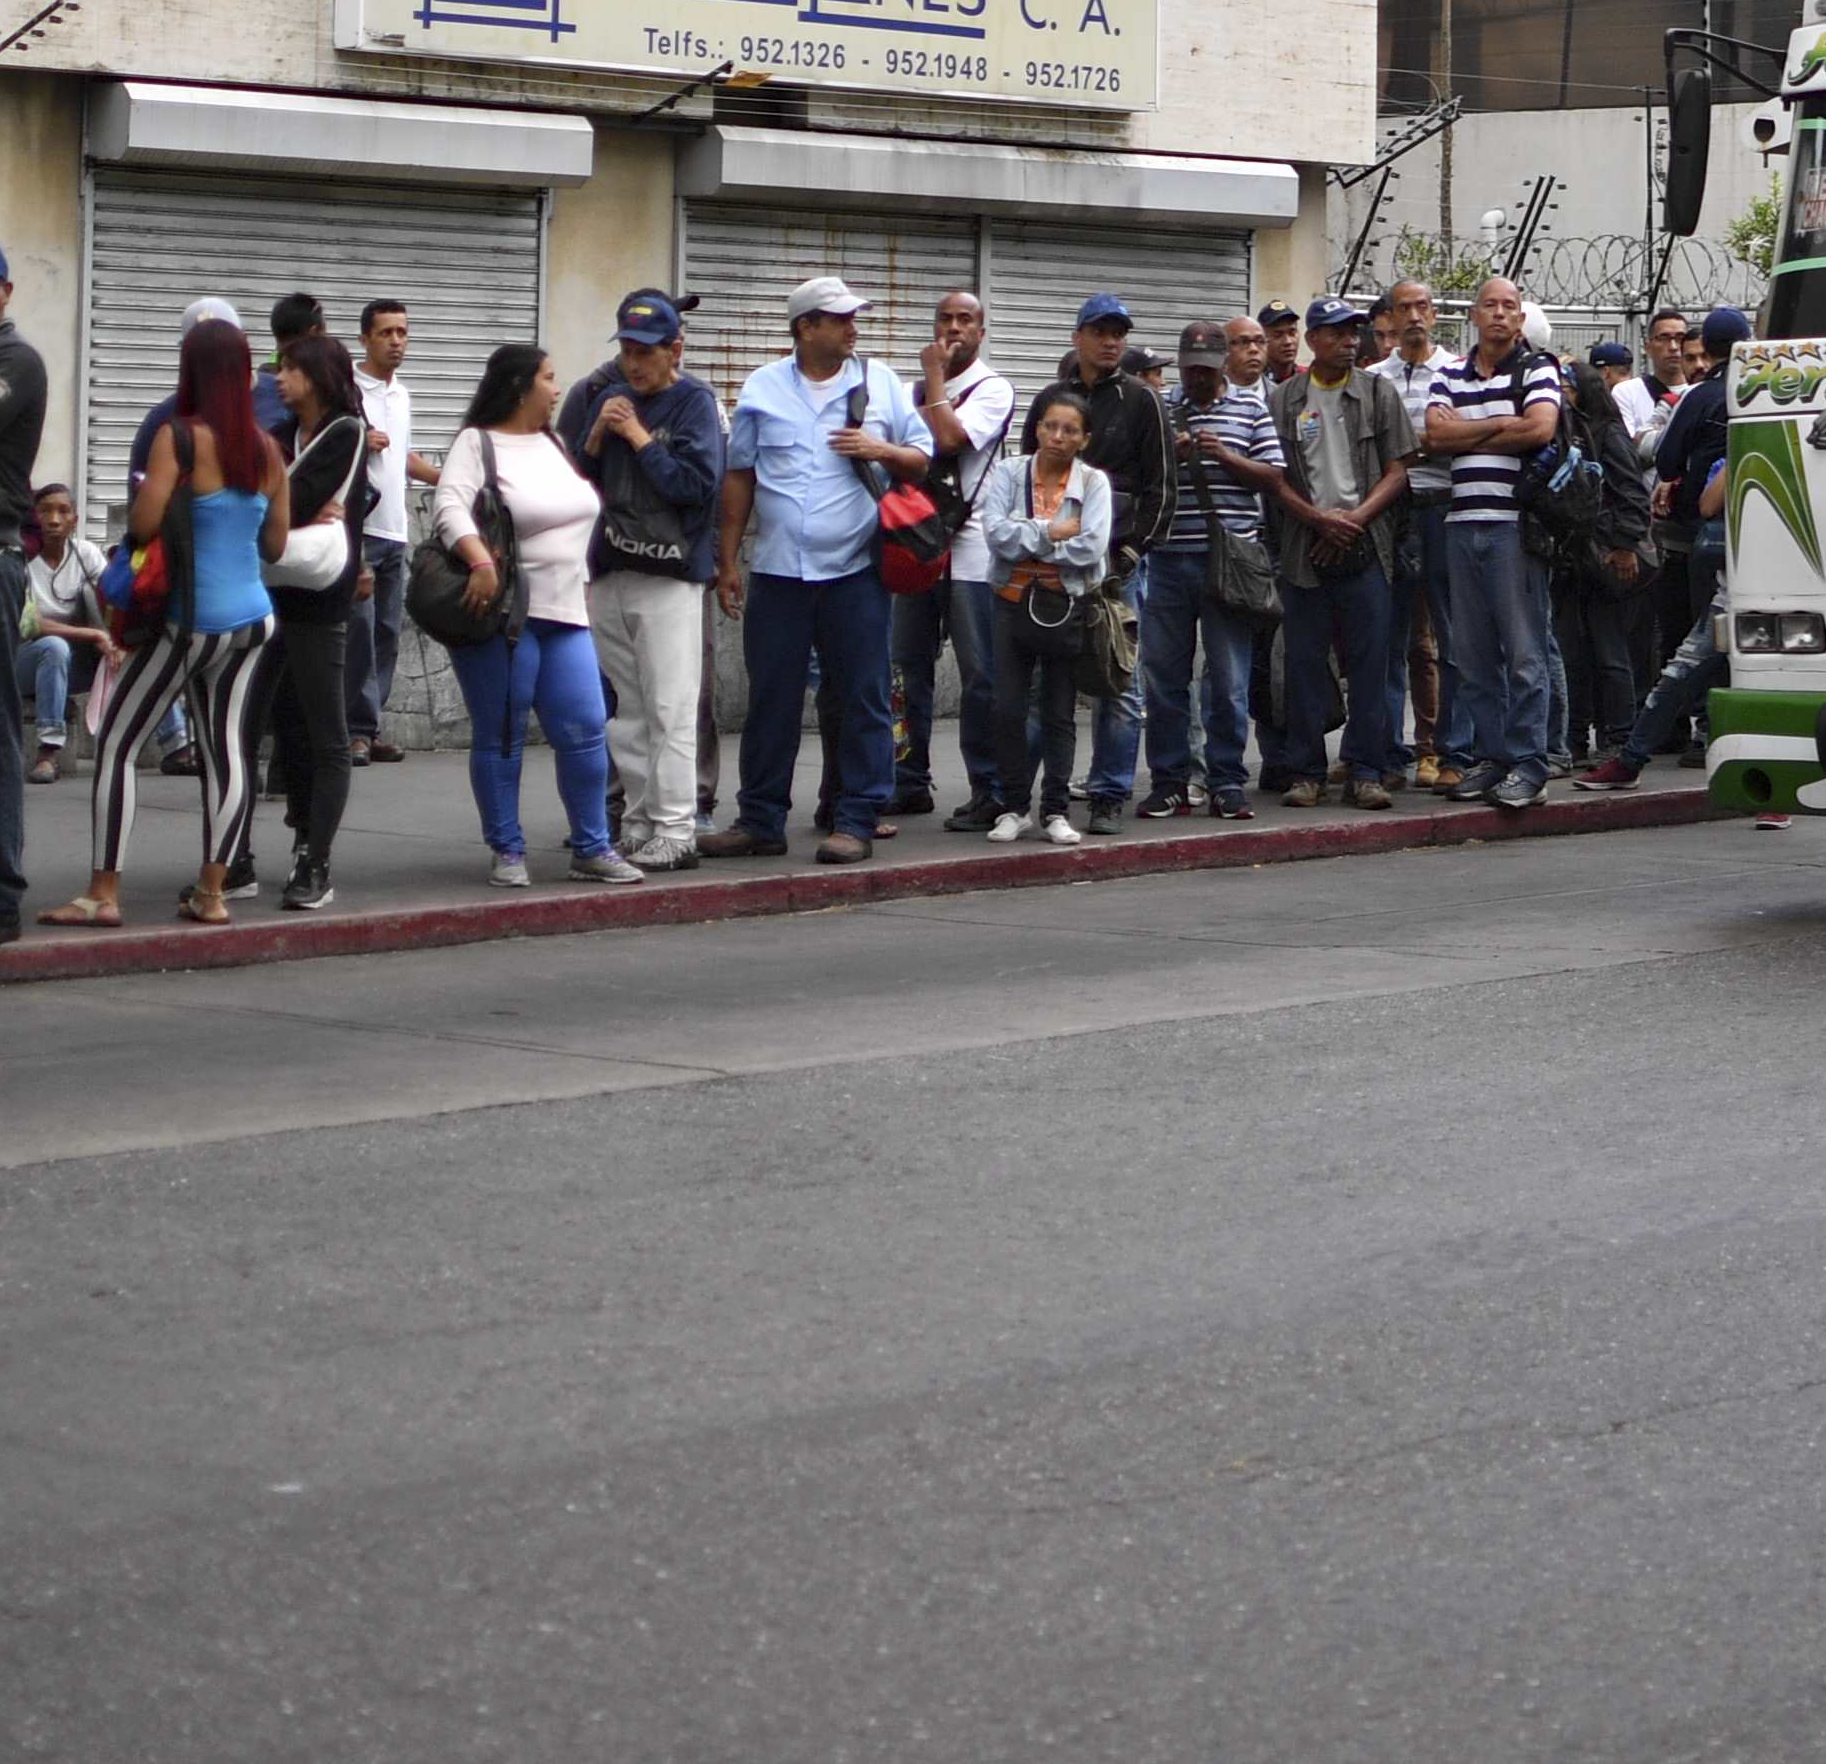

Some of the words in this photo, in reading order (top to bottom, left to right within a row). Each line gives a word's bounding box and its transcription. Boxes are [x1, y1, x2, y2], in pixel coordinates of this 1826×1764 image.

[643, 27, 725, 61] Telfs.:
[739, 35, 847, 70] 952.1326
[885, 48, 989, 83] 952.1948
[1024, 60, 1122, 94] 952.1726
[604, 525, 684, 560] NOKIA
